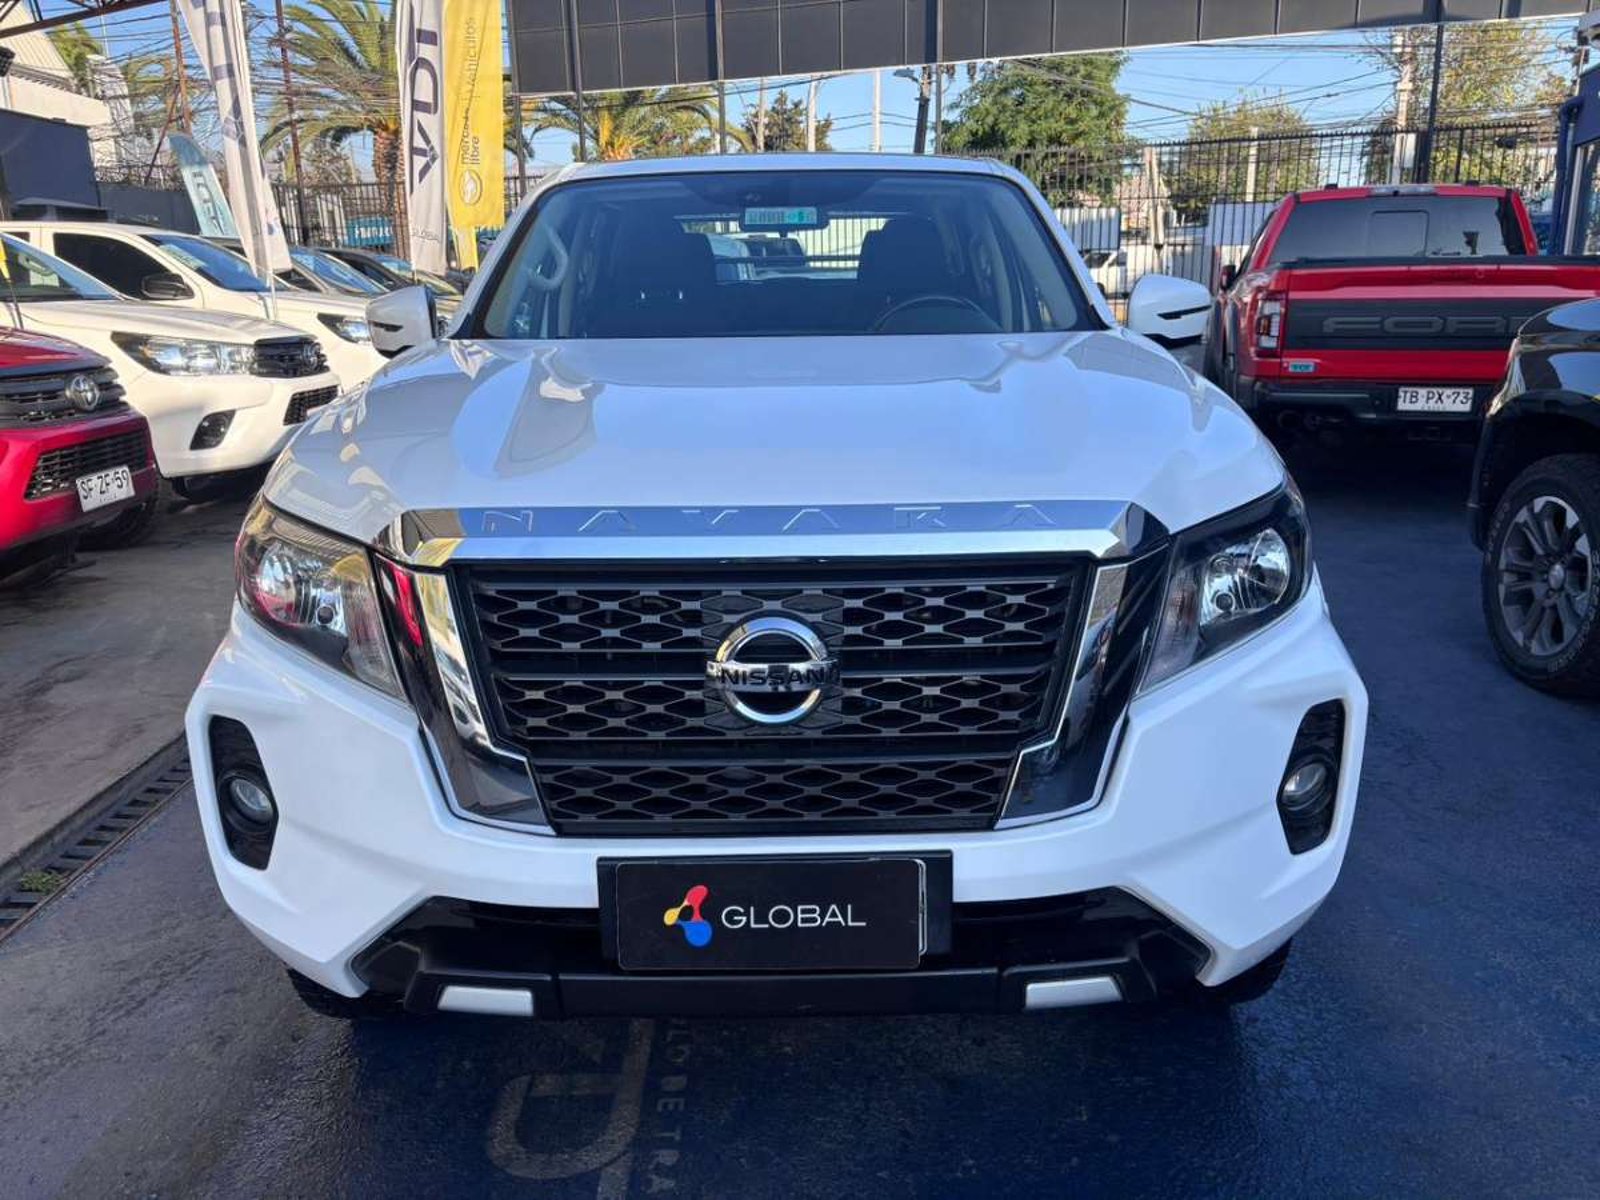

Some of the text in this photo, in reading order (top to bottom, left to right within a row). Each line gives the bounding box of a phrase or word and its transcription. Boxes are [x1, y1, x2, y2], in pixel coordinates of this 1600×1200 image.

[469, 136, 480, 164] libre
[481, 503, 1056, 532] NAVARA
[719, 665, 826, 686] NISSAN
[720, 903, 868, 930] GLOBAL
